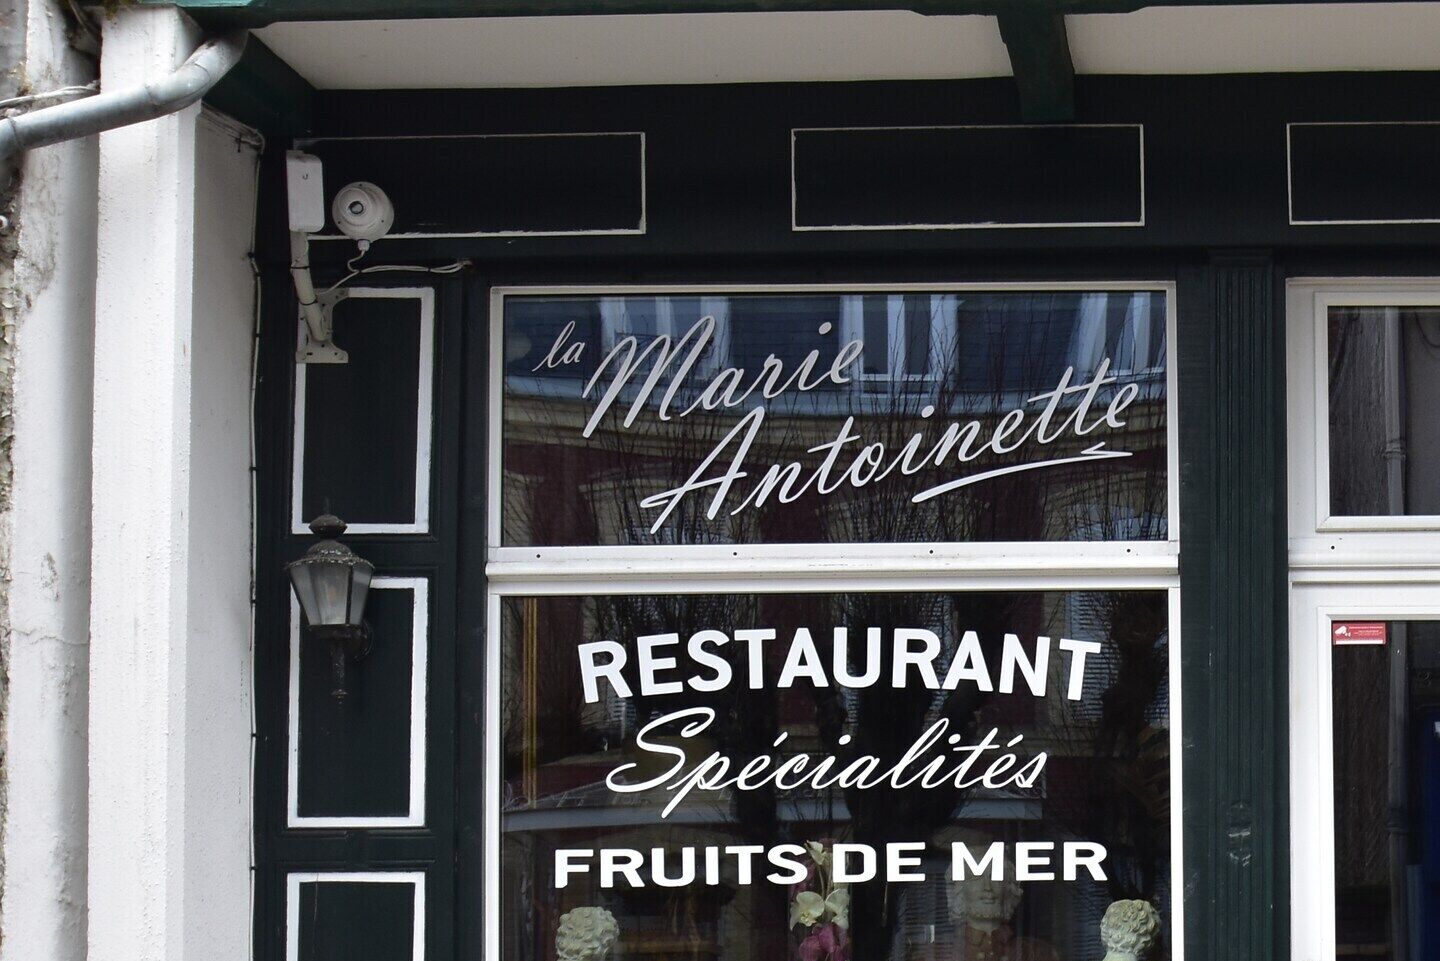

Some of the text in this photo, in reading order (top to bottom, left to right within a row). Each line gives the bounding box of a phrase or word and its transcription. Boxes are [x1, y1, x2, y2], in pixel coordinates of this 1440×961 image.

[532, 315, 866, 438] la Marie
[640, 357, 1139, 534] Antoinette
[577, 626, 1102, 703] RESTAURANT
[605, 706, 1049, 818] Spécialités
[554, 840, 1109, 888] FRUITS DE MER
